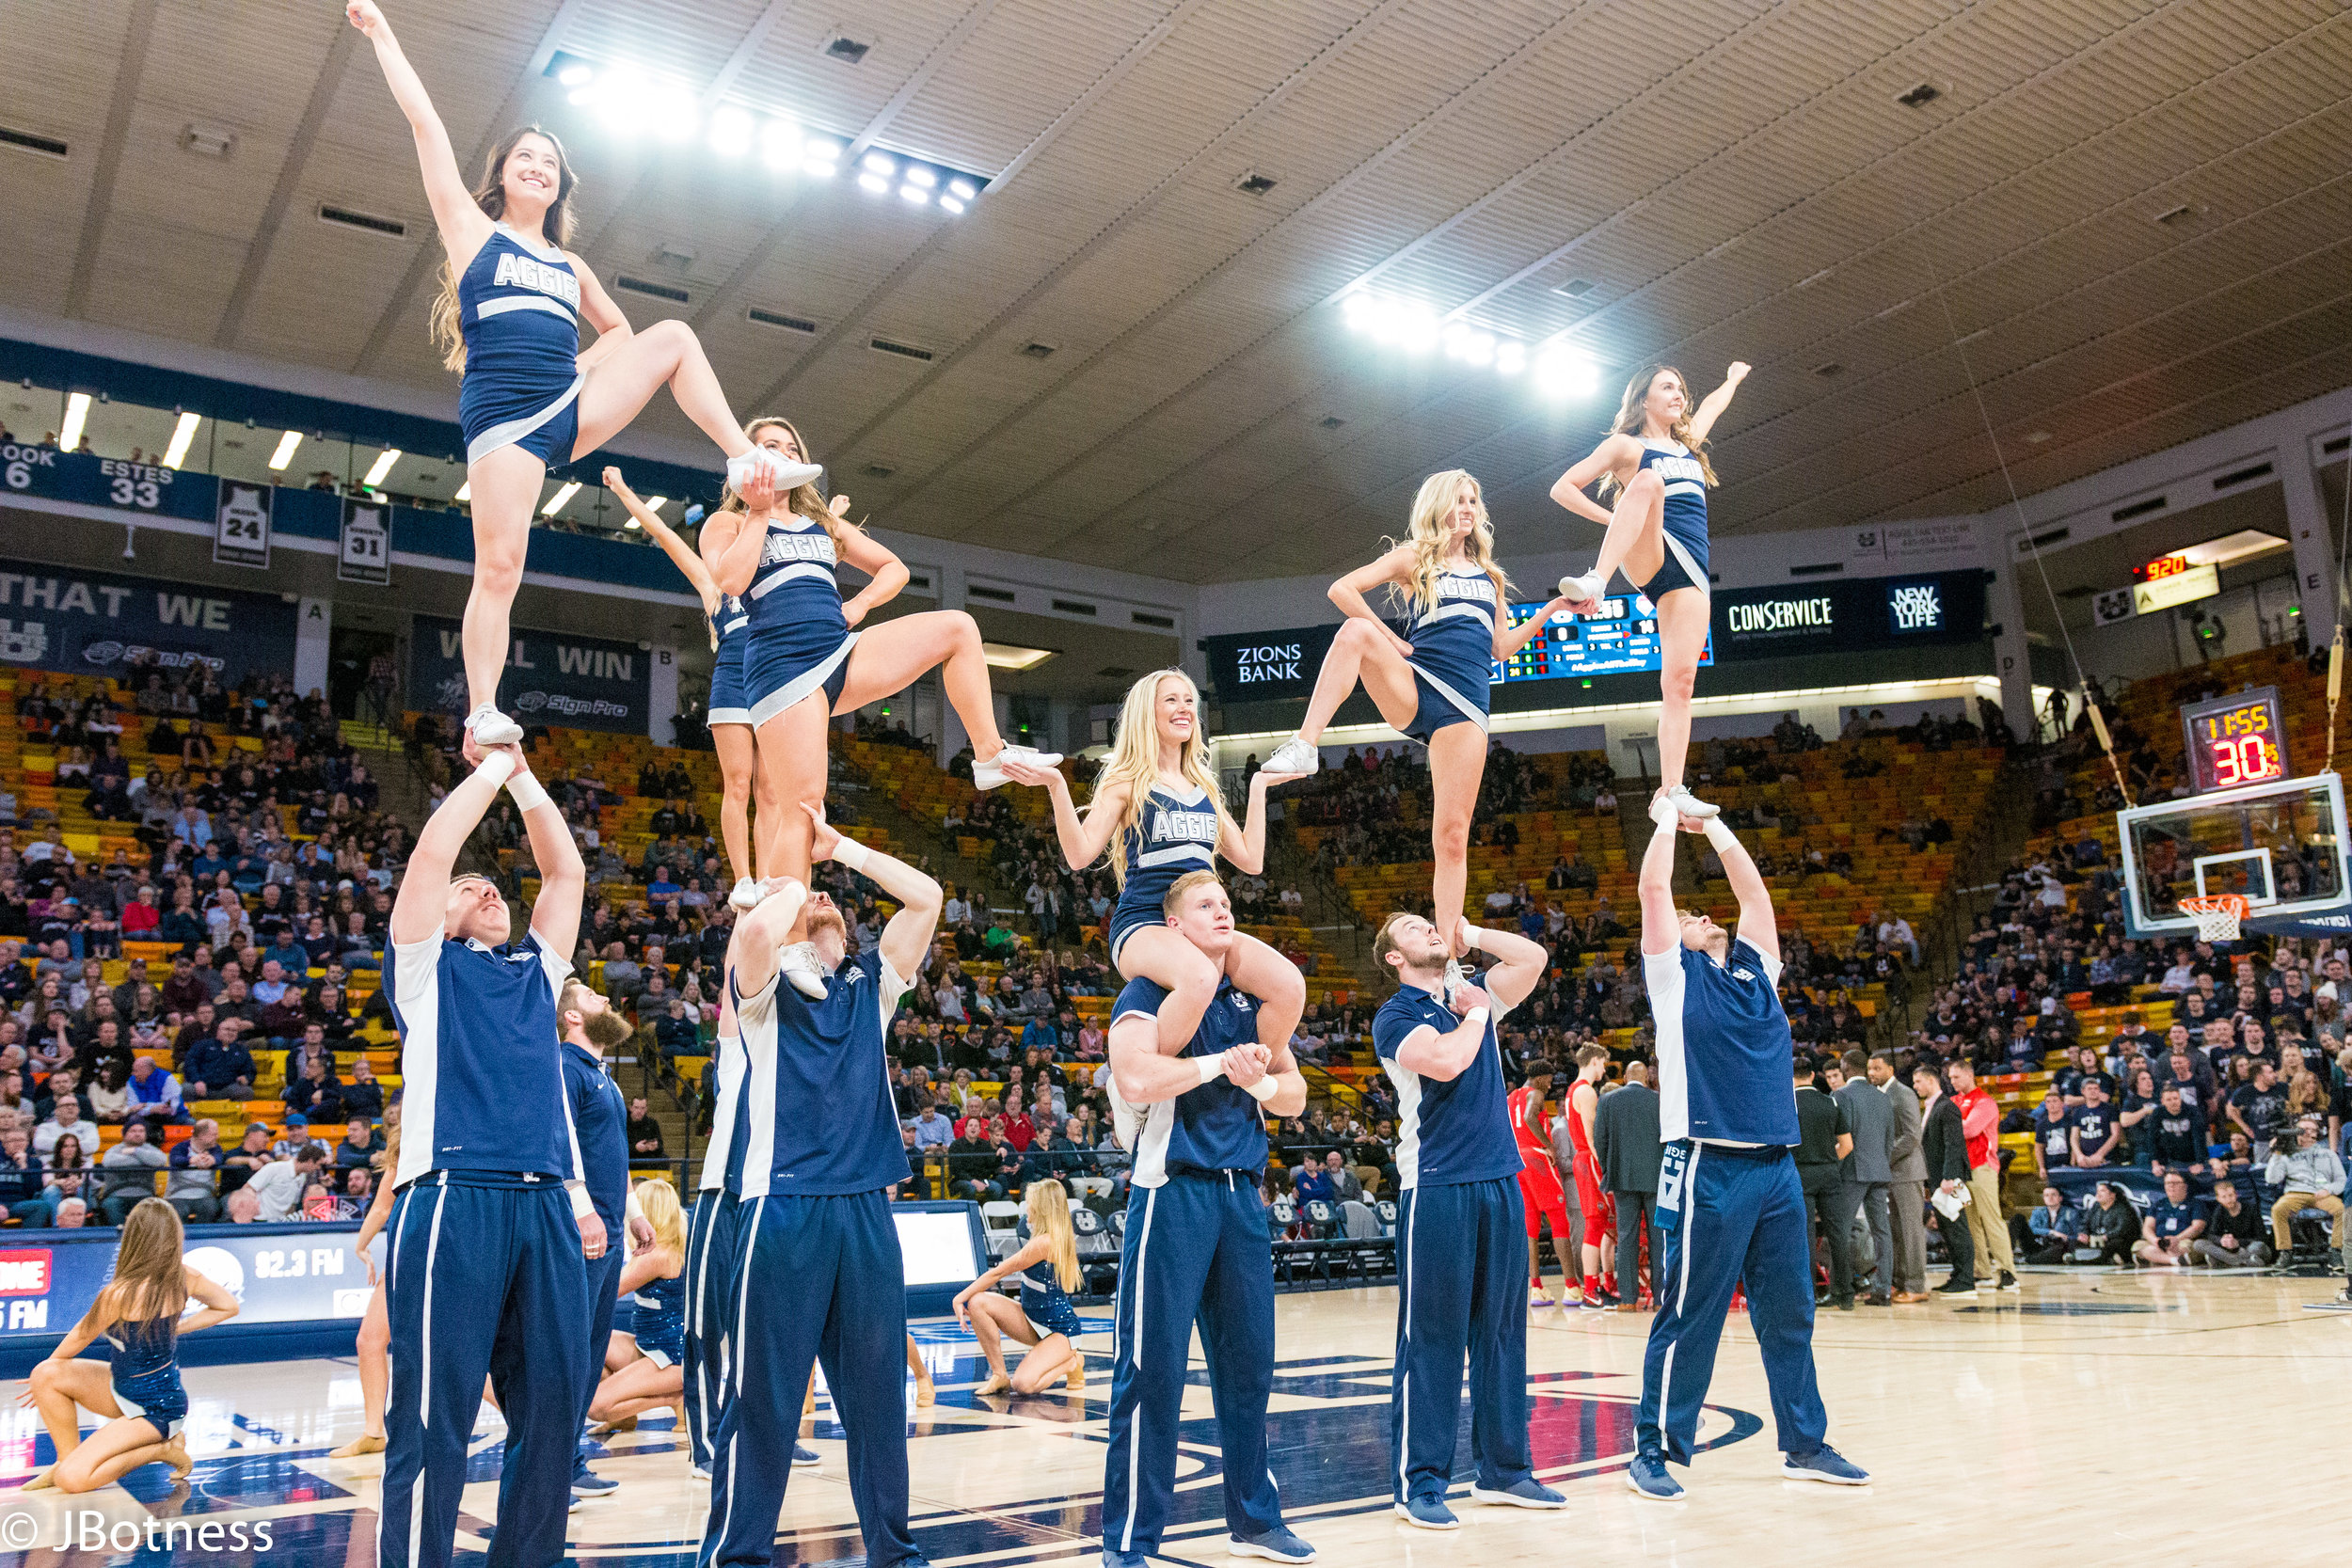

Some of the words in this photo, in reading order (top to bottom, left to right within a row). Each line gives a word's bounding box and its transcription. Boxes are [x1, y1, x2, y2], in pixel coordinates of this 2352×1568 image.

[6, 461, 31, 489] 6
[101, 459, 173, 485] ESTES
[110, 478, 159, 509] 33
[227, 519, 261, 541] 24
[351, 537, 378, 557] 31
[2146, 555, 2185, 581] 920
[1890, 597, 1941, 617] YORK
[1894, 585, 1935, 604] NEW
[157, 593, 231, 631] WE
[308, 604, 323, 621] A
[1728, 597, 1834, 632] CONSERVICE
[1898, 612, 1938, 629] LIFE
[439, 630, 535, 669] WL
[557, 645, 633, 681] WIN
[660, 651, 673, 665] B
[1237, 643, 1302, 664] ZIONS
[1238, 661, 1302, 684] BANK
[546, 694, 592, 716] Sign
[593, 700, 628, 718] Pro
[2208, 705, 2269, 739] 11:55
[2212, 735, 2268, 786] 30
[1515, 1103, 1522, 1128] 1
[255, 1249, 307, 1279] 92.3
[311, 1247, 344, 1276] FM
[8, 1299, 49, 1330] FM
